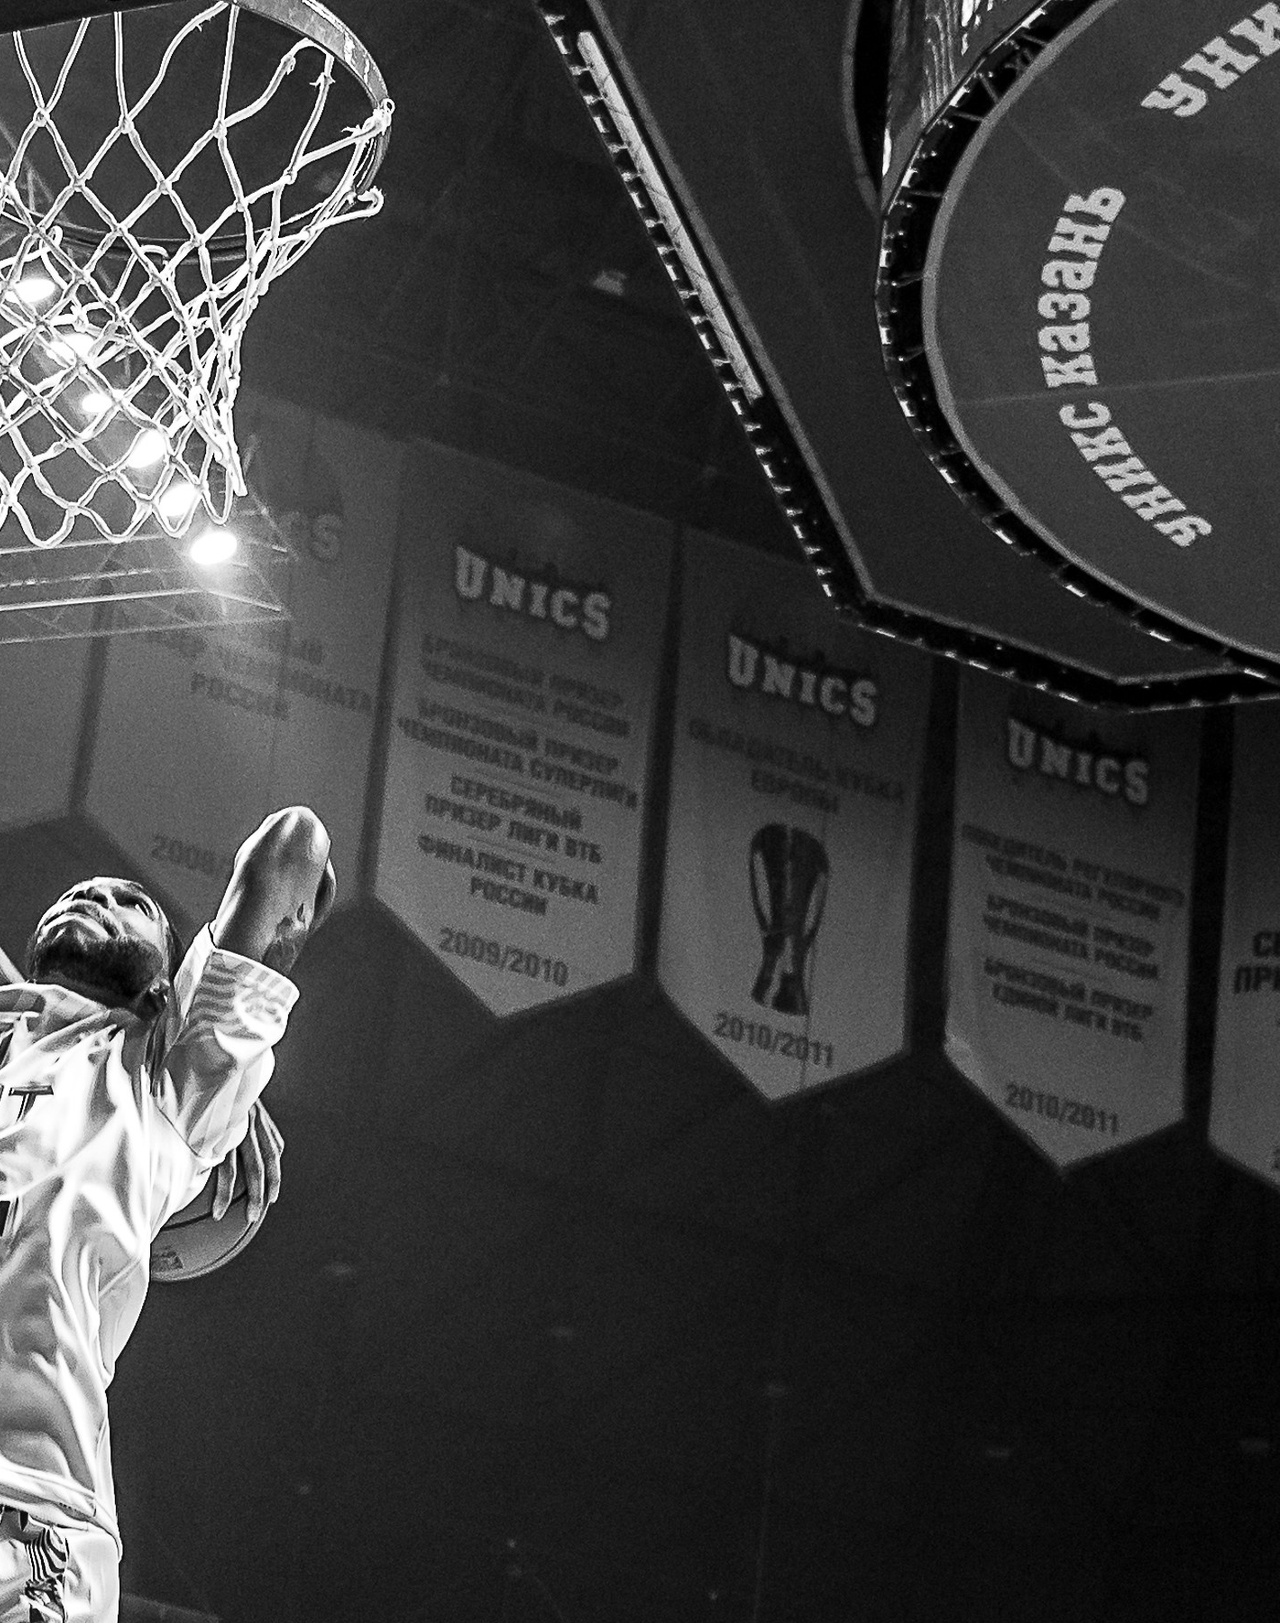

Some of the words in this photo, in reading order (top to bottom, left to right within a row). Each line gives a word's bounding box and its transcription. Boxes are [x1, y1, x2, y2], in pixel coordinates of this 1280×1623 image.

[1058, 401, 1213, 547] УНИКС
[455, 545, 611, 640] UNICS
[191, 670, 289, 721] РОССИИ
[729, 634, 877, 727] UNICS
[545, 737, 619, 777] ПРИЗЕР
[1008, 718, 1150, 806] UNICS
[425, 794, 502, 834] ПРИЗЕР
[507, 820, 558, 853] ЛИГИ
[565, 836, 601, 865] ВТБ
[451, 774, 582, 831] СЕРЕБРЯНЫЙ
[418, 833, 526, 884] ФИНАЛИСТ
[533, 867, 598, 905] КУБКА
[470, 875, 547, 916] РОССИИ
[439, 927, 569, 986] 2009/2010
[715, 1012, 834, 1067] 2010/2011
[1004, 1083, 1119, 1137] 2010/2011
